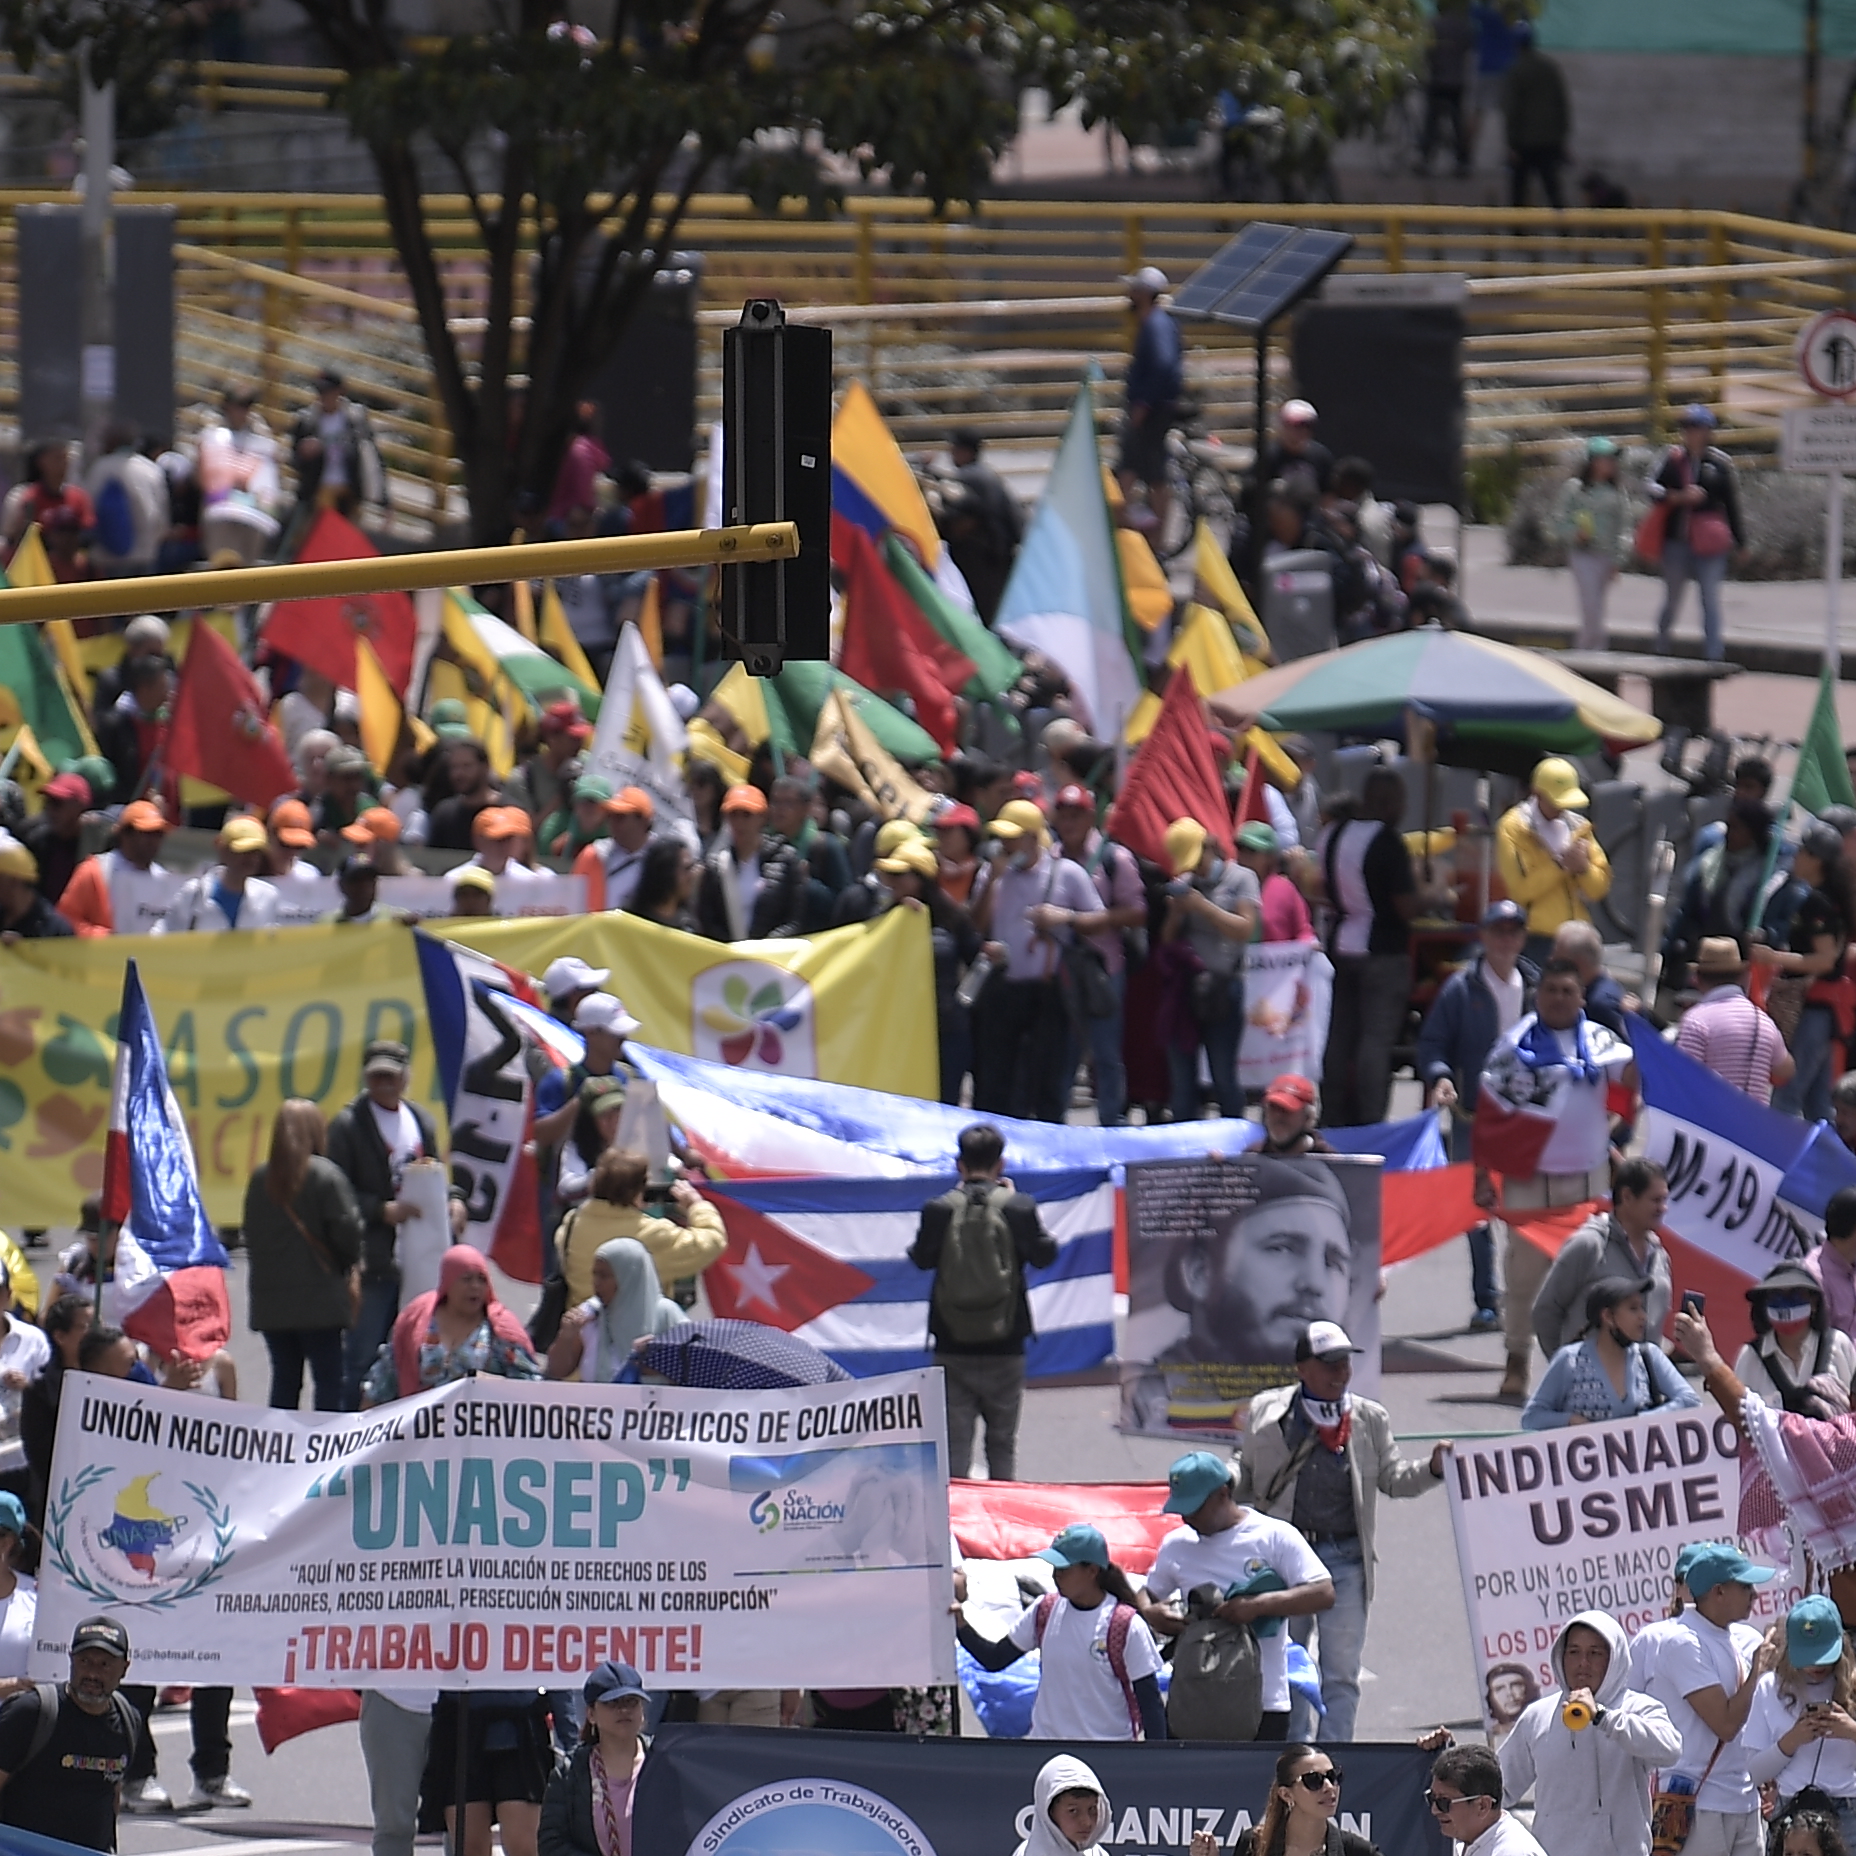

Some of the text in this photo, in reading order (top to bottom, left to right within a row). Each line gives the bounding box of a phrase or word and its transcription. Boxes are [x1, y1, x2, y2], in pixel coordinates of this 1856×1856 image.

[80, 1392, 924, 1464] UNIÓN NACIONAL SINDICAL DE SERVIDORES PÚBLICOS DE COLOMBIA
[1455, 1416, 1741, 1501] INDIGNADO
[97, 1514, 189, 1549] UNASEP
[783, 1502, 845, 1522] NACIÓN
[1529, 1474, 1725, 1546] USME
[335, 1563, 357, 1583] NO
[359, 1563, 379, 1582] SE
[381, 1562, 444, 1582] PERMITE
[446, 1561, 466, 1581] LA
[469, 1555, 548, 1582] VIOLACIÓN
[551, 1561, 571, 1581] DE
[574, 1560, 653, 1582] DERECHOS
[656, 1560, 676, 1582] DE
[679, 1560, 708, 1583] LOS
[1475, 1570, 1519, 1600] POR
[1521, 1564, 1551, 1593] UN
[1582, 1556, 1611, 1584] DE
[1615, 1547, 1672, 1576] MAYO
[214, 1592, 333, 1615] TRABAJADORES,
[336, 1591, 385, 1612] ACOSO
[387, 1588, 457, 1612] LABORAL,
[459, 1585, 563, 1612] PERSECUCIÓN
[565, 1589, 634, 1612] SINDICAL
[637, 1591, 656, 1611] NI
[1537, 1594, 1554, 1620] Y
[282, 1622, 704, 1683] ¡TRABAJO DECENTE!
[1484, 1626, 1531, 1660] LOS
[702, 1792, 785, 1854] Sindicato
[789, 1786, 815, 1801] de
